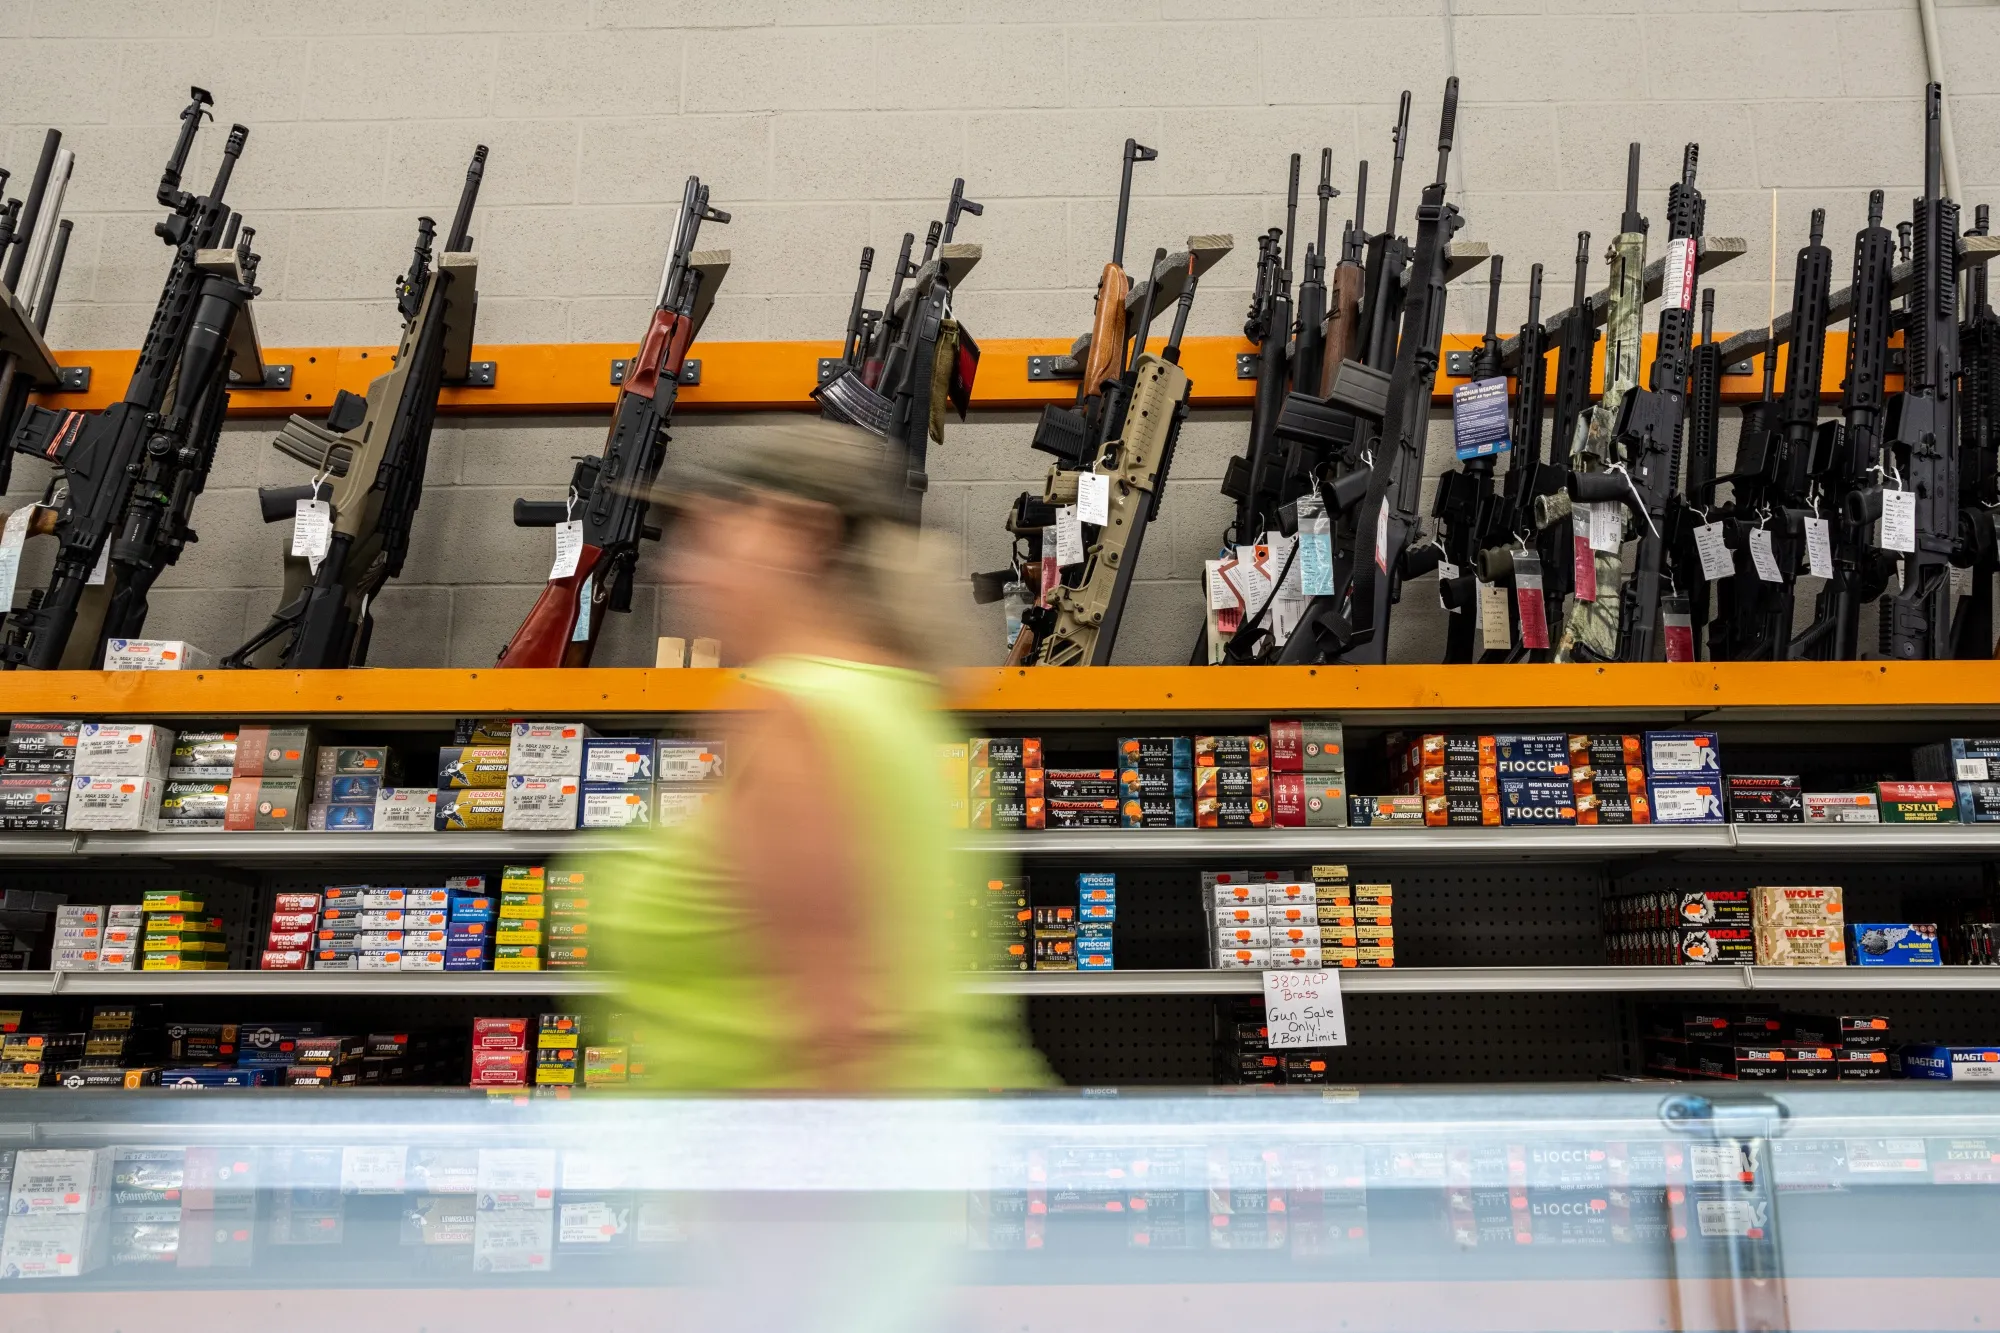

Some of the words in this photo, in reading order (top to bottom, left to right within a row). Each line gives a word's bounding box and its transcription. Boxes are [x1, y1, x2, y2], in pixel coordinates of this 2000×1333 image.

[1479, 384, 1504, 394] WEAPONRY
[474, 764, 508, 772] TUNGSTEN
[1279, 784, 1287, 792] 12
[1898, 803, 1943, 812] ESTATE
[1391, 812, 1423, 820] TUNGSTEN
[1507, 807, 1570, 818] FIOCCH
[1704, 891, 1747, 901] WOLF
[1784, 890, 1824, 898] WOLF
[1708, 930, 1750, 939] WOLF
[1784, 929, 1826, 938] WOLF
[1270, 974, 1300, 989] 380
[1303, 972, 1328, 986] ACP
[1280, 988, 1318, 1002] Brass
[1268, 1007, 1298, 1022] Gun
[1304, 1006, 1334, 1019] Sale
[1288, 1018, 1320, 1036] Only!
[1854, 1020, 1872, 1028] Blaz
[249, 1033, 280, 1042] PPU
[1270, 1032, 1278, 1045] 1
[1280, 1032, 1302, 1044] Box
[1306, 1030, 1338, 1043] Limit
[304, 1050, 330, 1058] 10MM
[1908, 1056, 1945, 1068] MAGTECH
